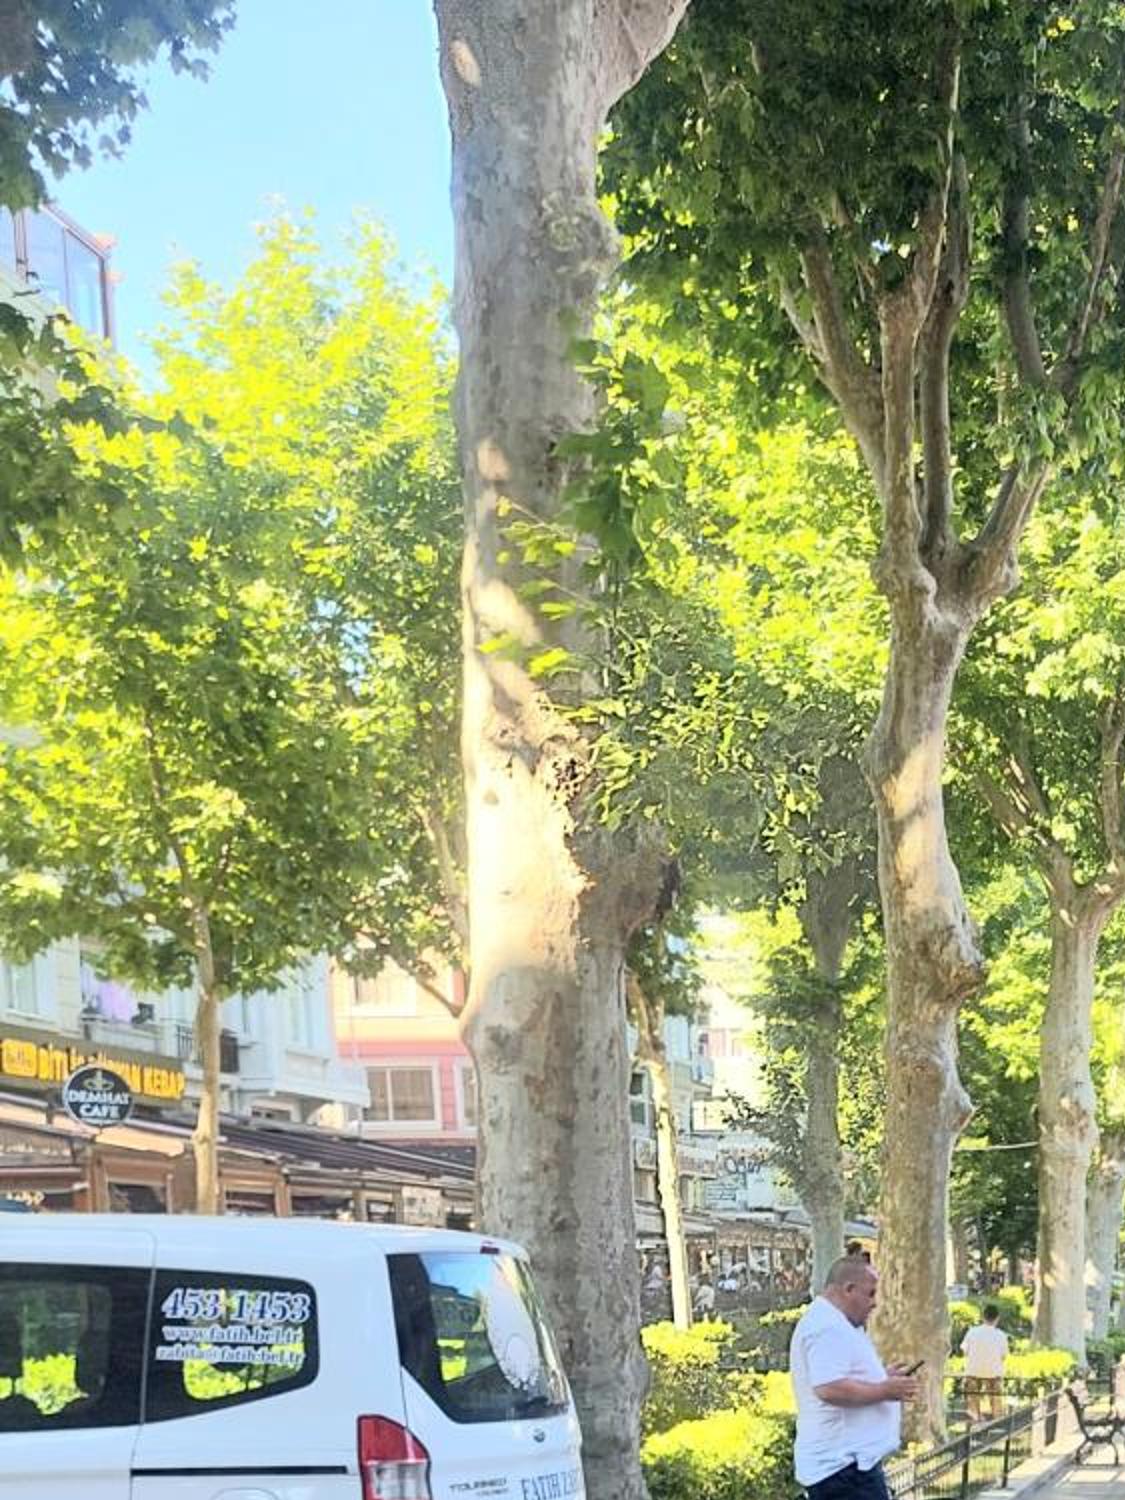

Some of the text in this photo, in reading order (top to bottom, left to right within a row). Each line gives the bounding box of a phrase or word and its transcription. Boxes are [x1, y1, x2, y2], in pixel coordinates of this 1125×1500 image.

[79, 1104, 120, 1118] CAFE
[161, 1287, 311, 1323] 453 1453
